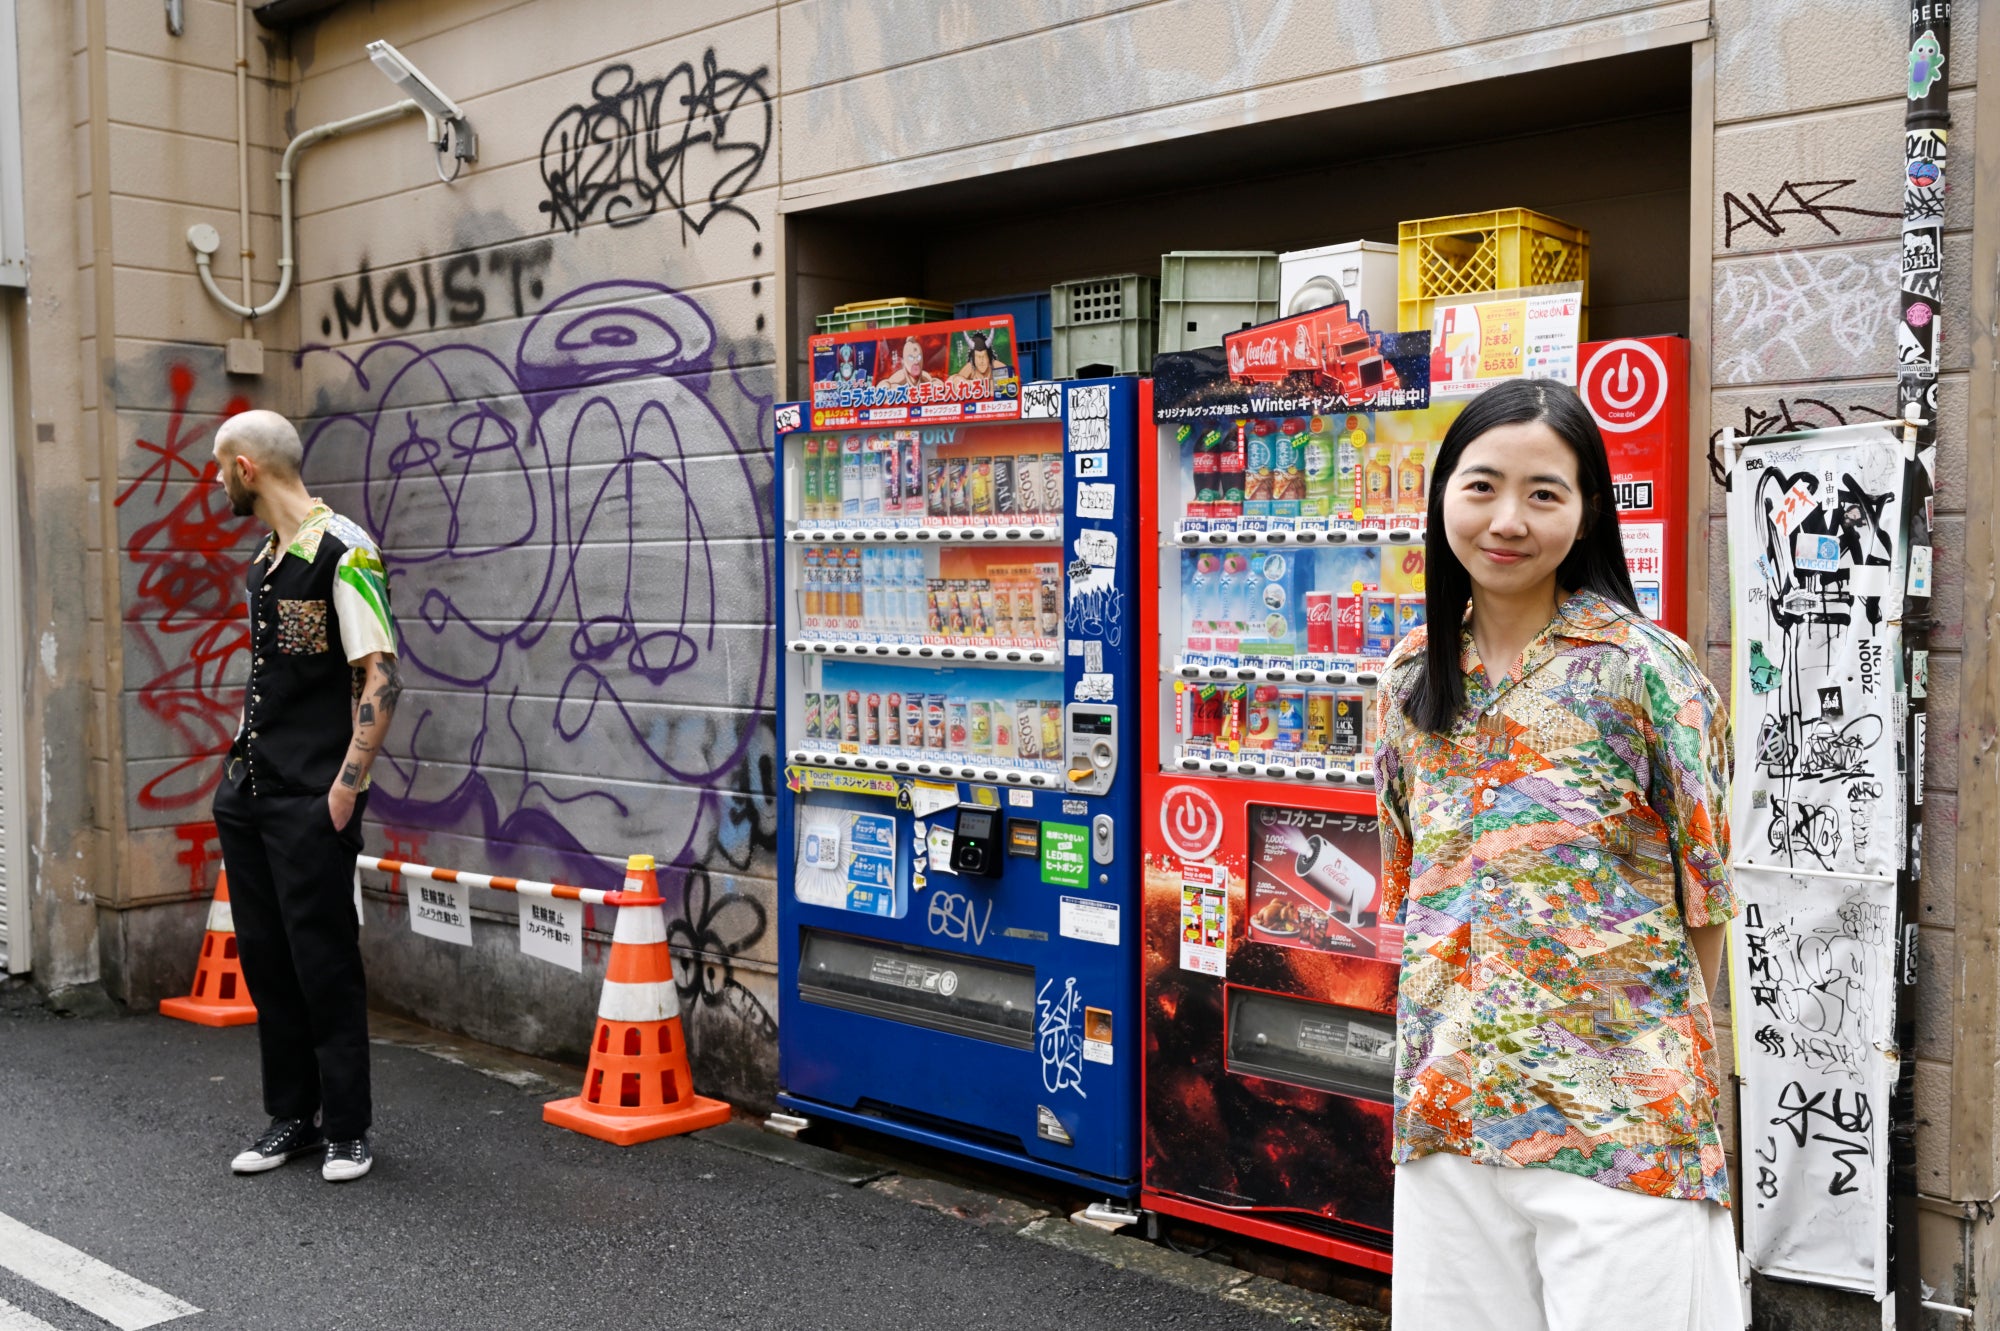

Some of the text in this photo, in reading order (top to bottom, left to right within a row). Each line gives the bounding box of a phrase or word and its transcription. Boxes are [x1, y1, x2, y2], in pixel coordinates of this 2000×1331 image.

[1157, 403, 1249, 419] オリジナルグッズが当たる
[1613, 473, 1633, 481] HELLO
[1796, 558, 1838, 570] WIGGLE
[1858, 639, 1873, 694] NOODZ
[1019, 715, 1036, 753] BOSS
[809, 770, 834, 780] Touch!
[421, 887, 456, 909] 駐輪禁止
[532, 904, 564, 927] 駐輪禁止
